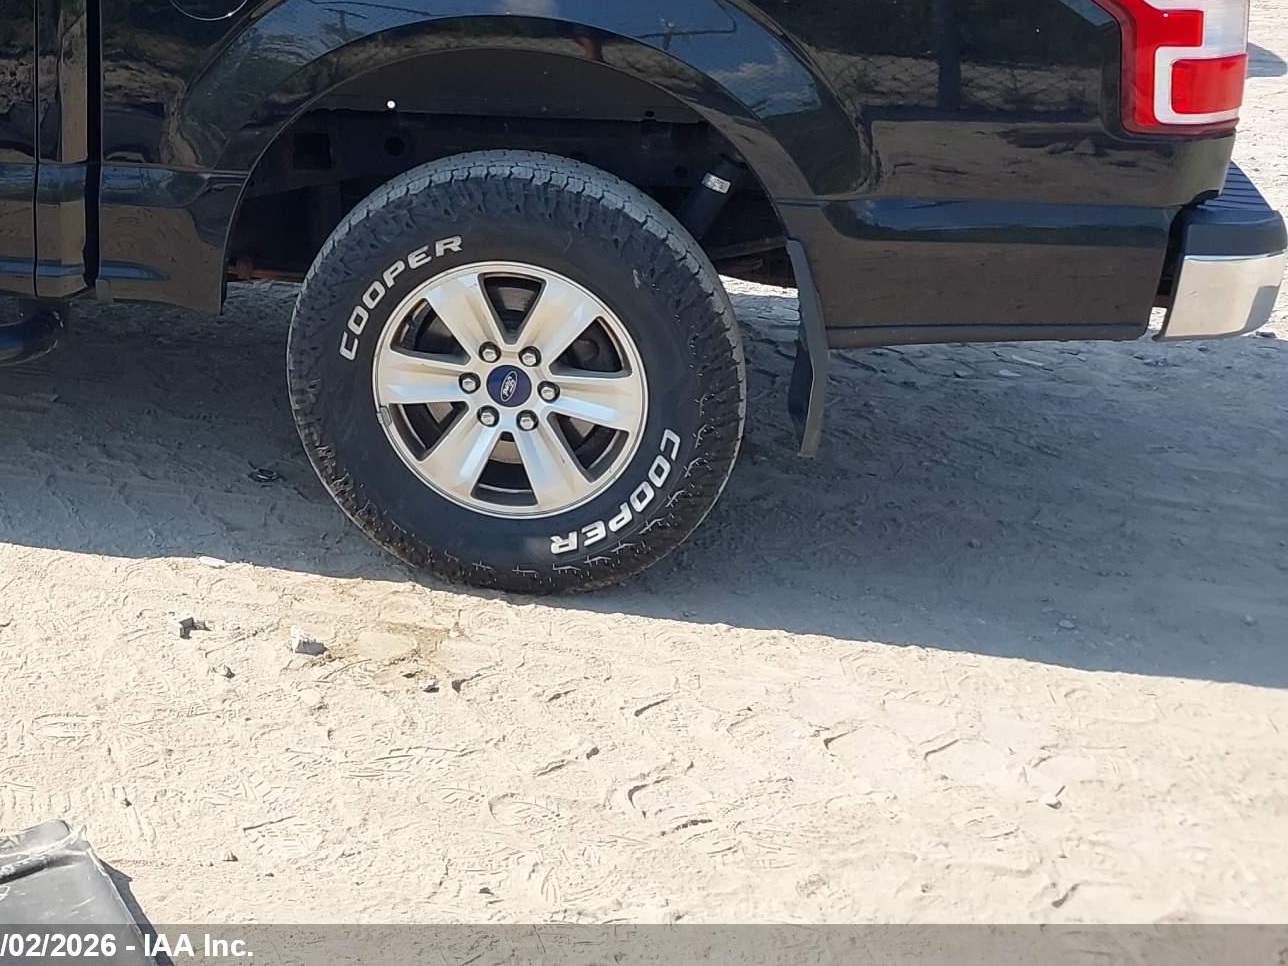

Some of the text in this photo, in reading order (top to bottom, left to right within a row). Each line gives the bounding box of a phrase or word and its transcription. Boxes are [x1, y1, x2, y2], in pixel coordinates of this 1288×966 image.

[339, 234, 463, 361] COOPER
[502, 373, 516, 399] Ford
[549, 428, 681, 556] COOPER
